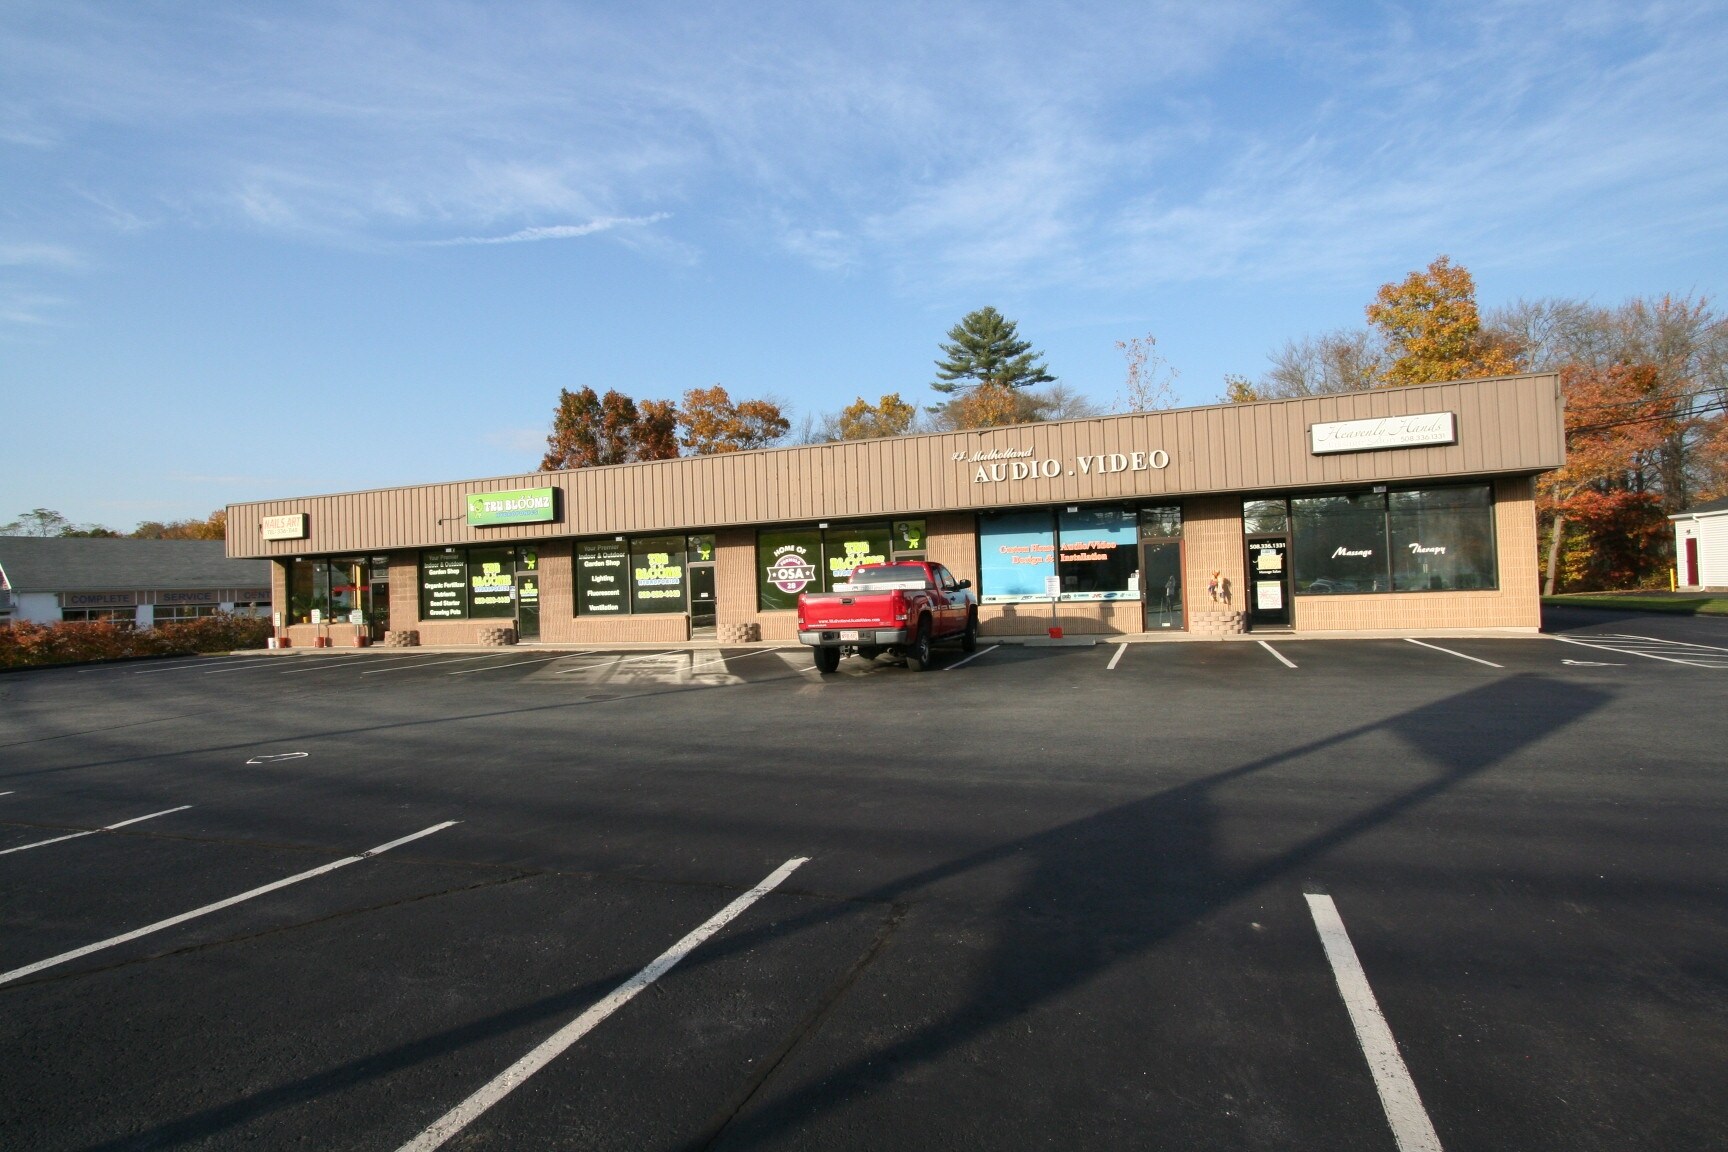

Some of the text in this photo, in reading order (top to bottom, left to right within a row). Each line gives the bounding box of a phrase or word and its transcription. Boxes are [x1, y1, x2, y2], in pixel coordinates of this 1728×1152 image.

[1318, 413, 1447, 441] Heavenly Hands
[968, 446, 1035, 463] Mulholland
[974, 459, 1061, 483] AUDIO
[484, 501, 504, 512] TRU
[264, 516, 302, 530] NAILS ART
[773, 545, 807, 557] HOME OF
[1331, 542, 1446, 558] Massage Therapy
[1060, 552, 1108, 562] Installation
[591, 575, 615, 583] Lighting
[778, 568, 805, 580] OSA
[71, 594, 130, 605] COMPLETE
[163, 592, 213, 602] SERVICE
